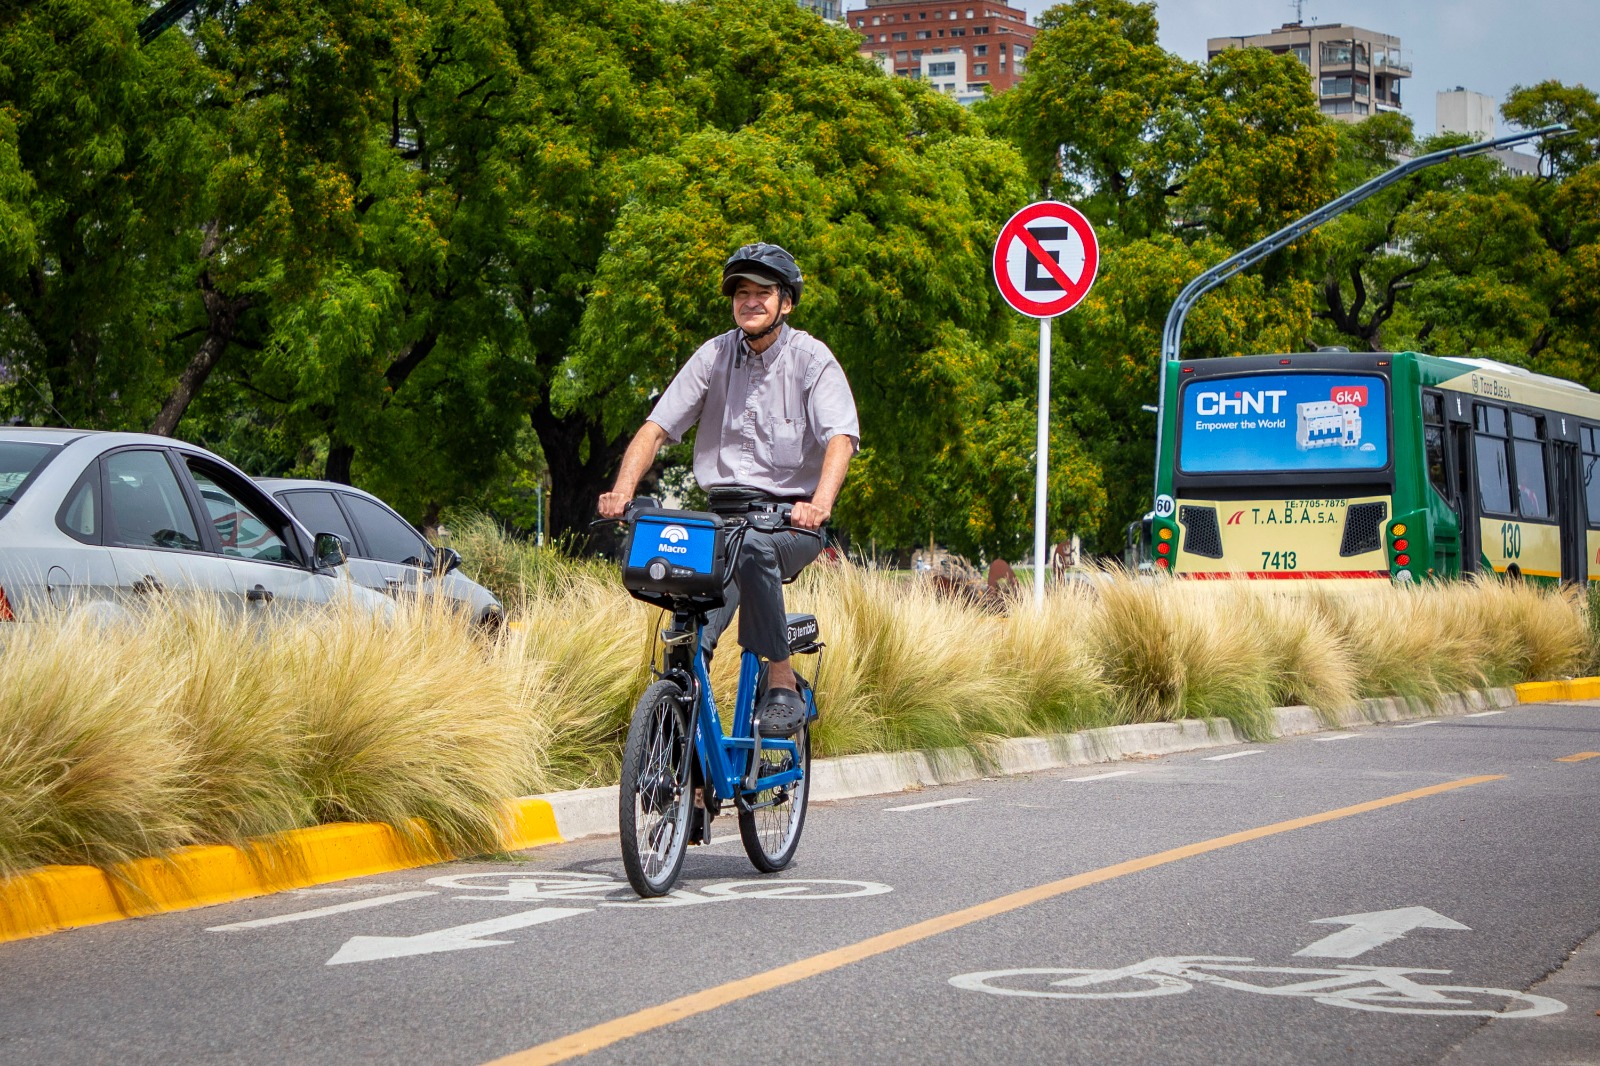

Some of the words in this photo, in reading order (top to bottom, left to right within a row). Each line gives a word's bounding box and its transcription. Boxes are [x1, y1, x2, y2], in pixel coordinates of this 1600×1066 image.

[1025, 226, 1068, 291] E
[1336, 390, 1362, 403] 6kA
[1195, 420, 1238, 432] Empower
[1241, 419, 1256, 429] the
[1258, 418, 1286, 429] World
[1157, 499, 1171, 513] 60
[1501, 522, 1521, 559] 130
[658, 543, 687, 554] Macro
[1261, 551, 1297, 570] 7413
[797, 620, 816, 637] tembici
